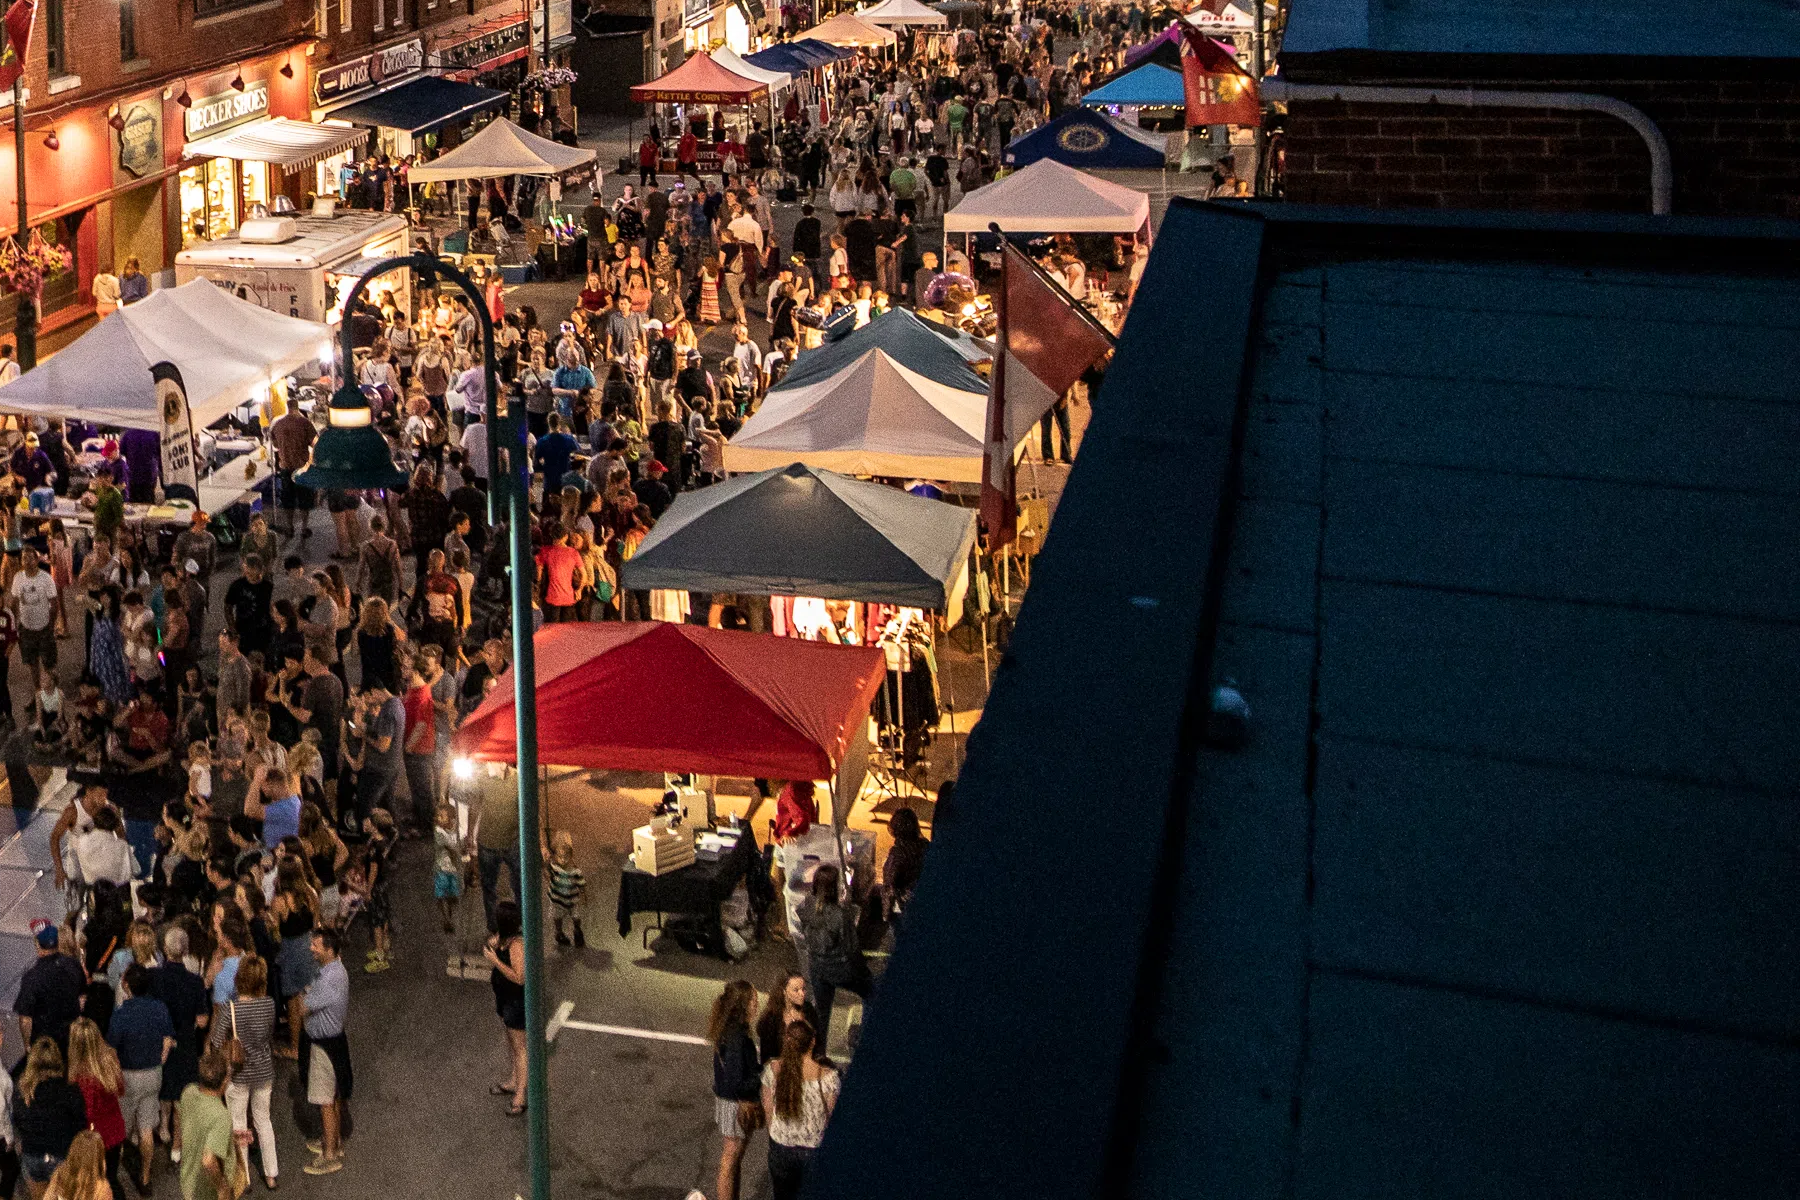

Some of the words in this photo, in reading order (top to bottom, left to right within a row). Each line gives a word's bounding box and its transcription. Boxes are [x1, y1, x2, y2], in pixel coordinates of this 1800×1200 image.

[339, 65, 370, 91] MOOSE
[189, 100, 234, 132] BECKER
[233, 86, 267, 118] SHOES
[656, 91, 691, 101] KETTLE
[694, 91, 721, 101] CORN
